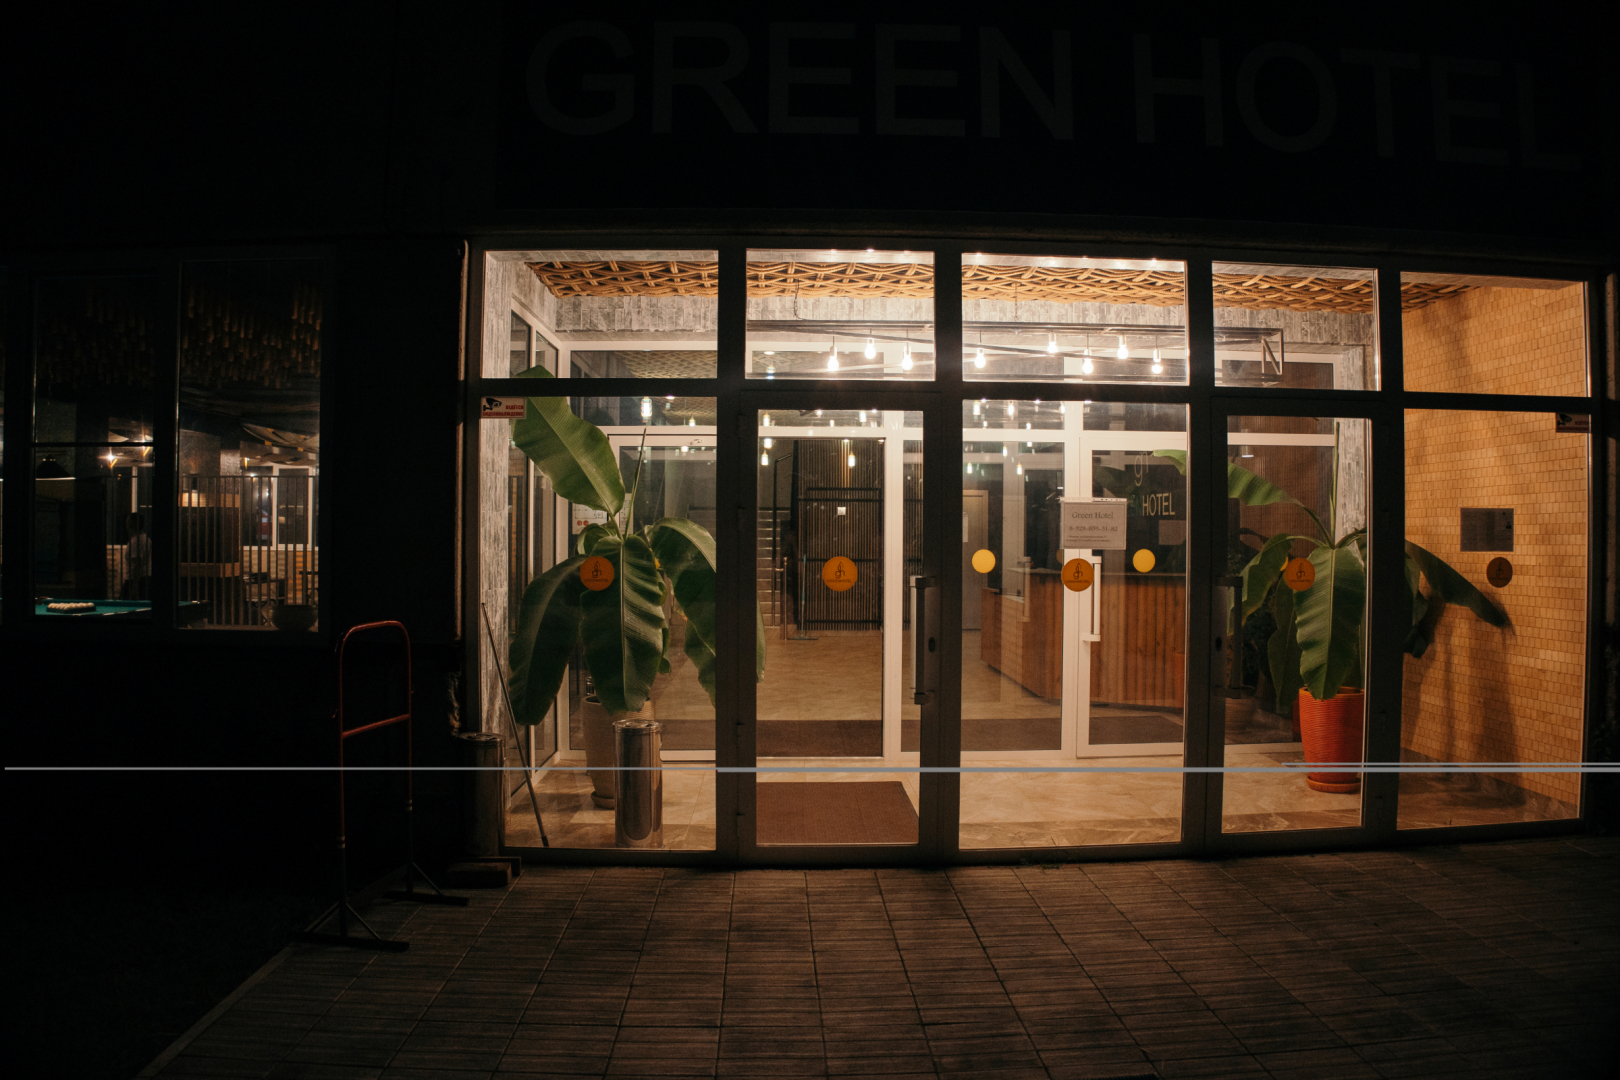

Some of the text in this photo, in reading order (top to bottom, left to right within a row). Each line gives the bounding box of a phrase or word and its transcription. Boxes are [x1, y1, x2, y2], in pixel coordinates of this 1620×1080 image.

[525, 20, 1582, 172] GREEN HOTEL
[1142, 492, 1175, 516] HOTEL
